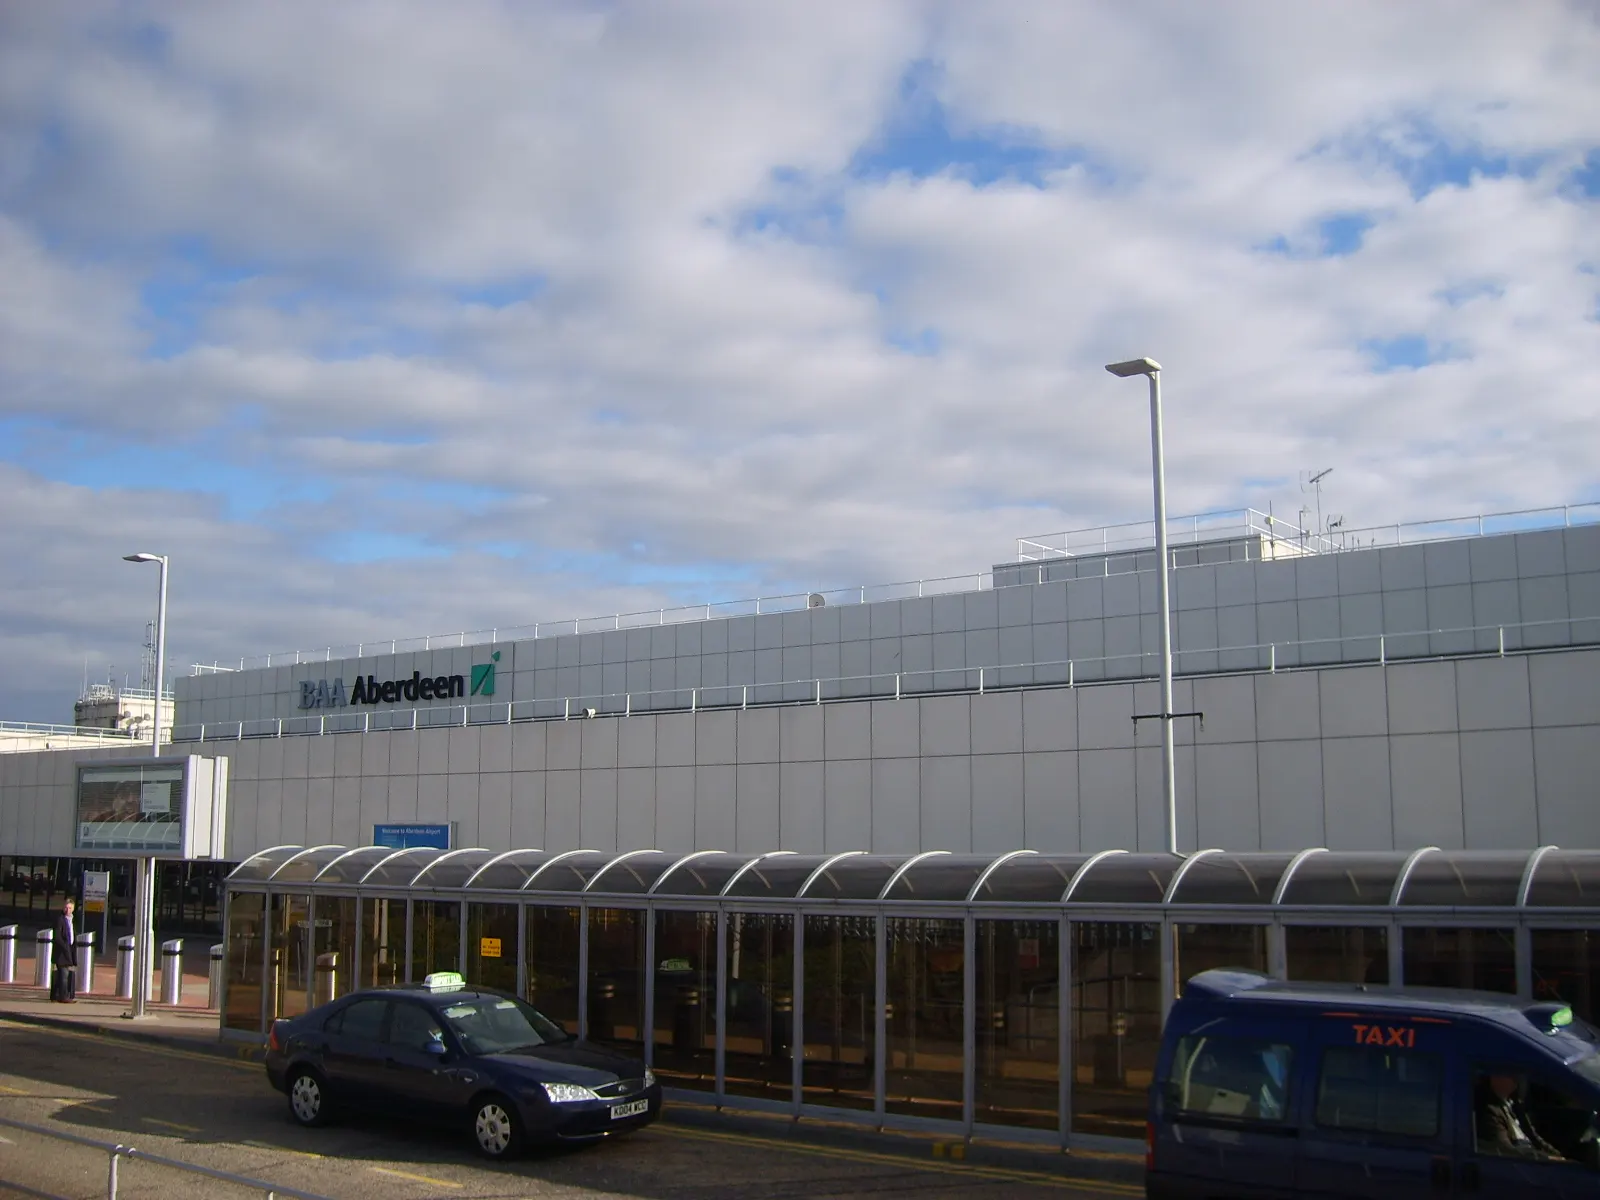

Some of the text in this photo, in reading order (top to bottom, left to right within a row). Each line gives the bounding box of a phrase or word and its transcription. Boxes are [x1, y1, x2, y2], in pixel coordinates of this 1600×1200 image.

[298, 671, 464, 709] BAA Aberdeen
[1352, 1024, 1415, 1048] TAXI
